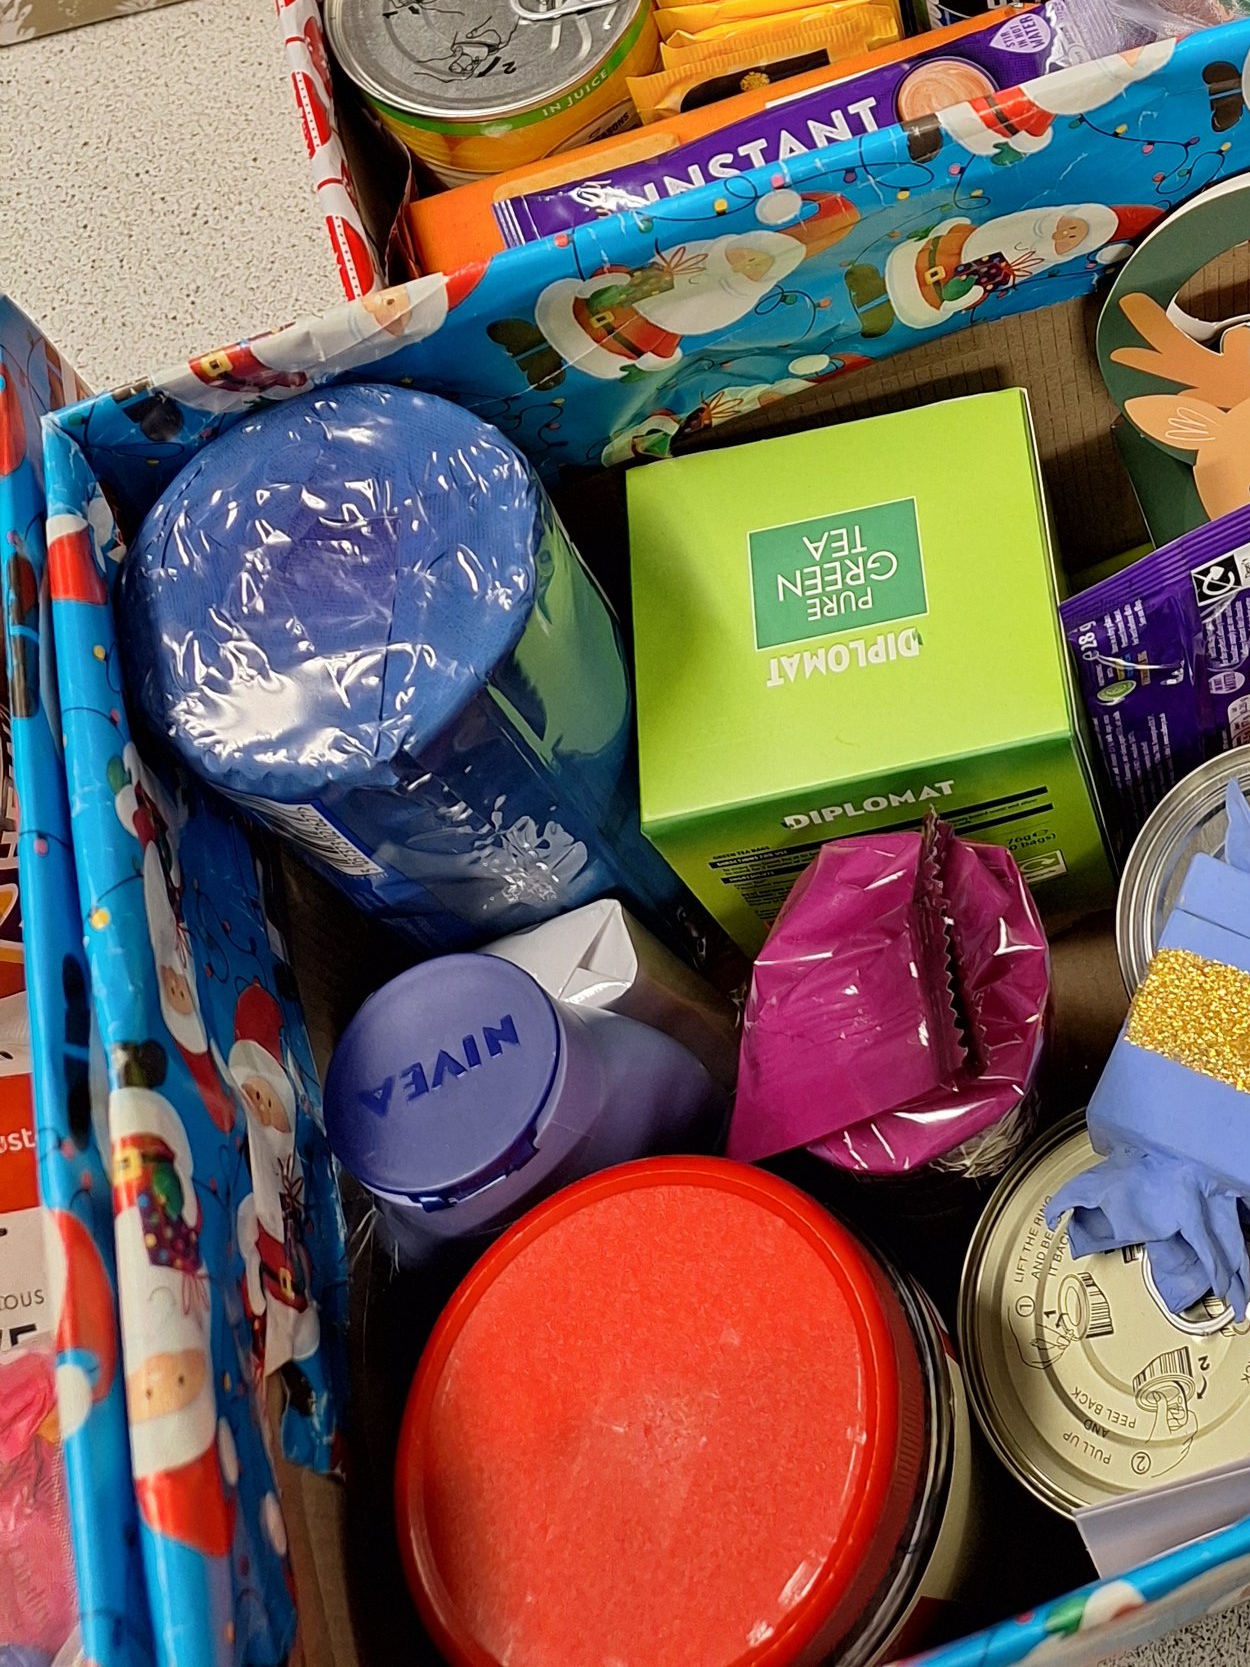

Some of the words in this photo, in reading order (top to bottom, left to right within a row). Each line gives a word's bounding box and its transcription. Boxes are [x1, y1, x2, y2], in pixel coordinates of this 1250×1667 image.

[1001, 31, 1015, 48] STIR
[1010, 24, 1024, 39] HOT
[1019, 15, 1045, 48] WATER
[542, 103, 562, 117] IN
[567, 68, 608, 107] JUICE
[801, 523, 868, 562] TEA
[776, 548, 899, 602] GREEN
[805, 586, 875, 622] PURE
[766, 626, 921, 688] DIPLOMAT
[783, 778, 957, 831] DIPLOMAT
[357, 1014, 522, 1120] NIVEA
[1013, 1256, 1029, 1284] LIFT
[1022, 1227, 1039, 1255] THE
[1052, 1231, 1070, 1264] BAC
[1031, 1251, 1047, 1281] AND
[1047, 1264, 1059, 1277] IT
[1071, 1385, 1103, 1416] BACK
[1083, 1417, 1111, 1439] AND
[1105, 1406, 1137, 1429] PEEL
[1062, 1430, 1081, 1447] UP
[1080, 1440, 1113, 1465] PULL
